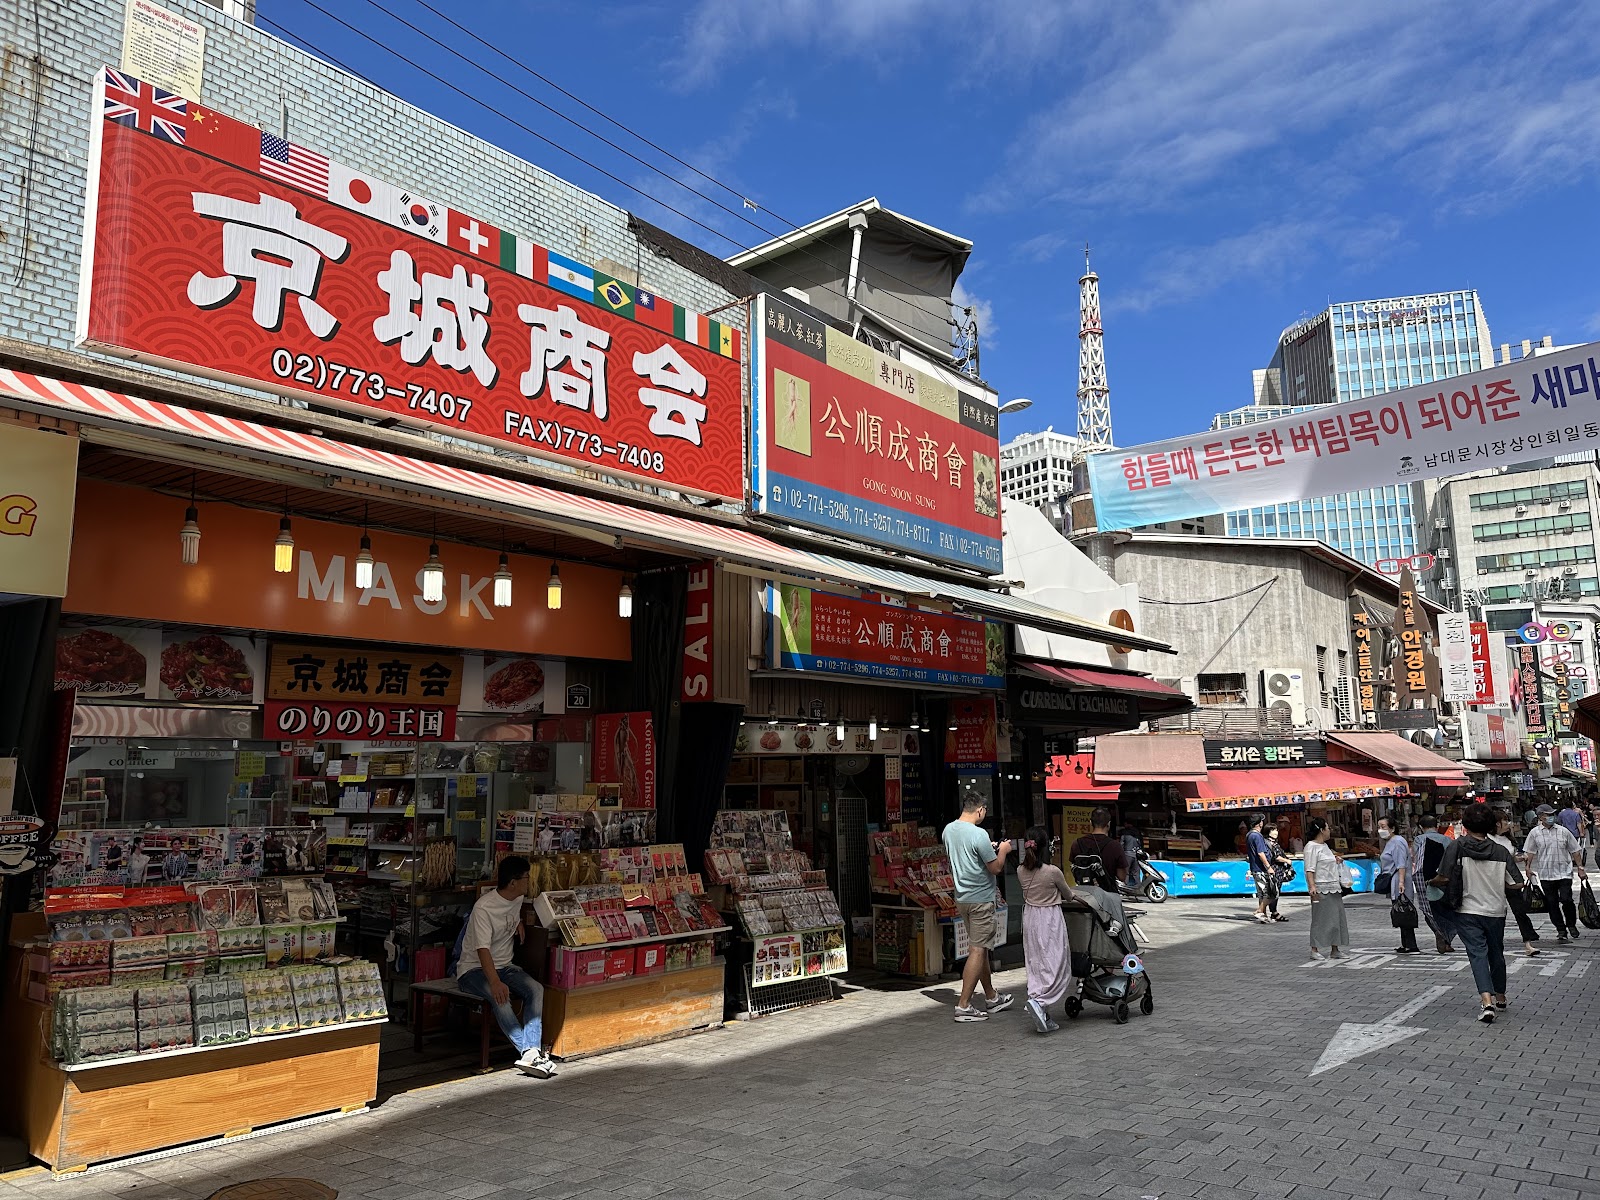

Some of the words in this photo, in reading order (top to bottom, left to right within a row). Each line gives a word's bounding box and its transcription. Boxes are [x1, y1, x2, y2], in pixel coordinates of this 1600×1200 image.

[187, 191, 708, 446] 京城商会
[1363, 295, 1449, 314] COURTYARD
[1283, 311, 1329, 346] COURTYARD
[272, 348, 472, 424] 02)773-7407
[504, 410, 665, 474] FAX)773-7408
[819, 396, 967, 489] 公順成商會
[1121, 447, 1199, 491] 힘들때
[1203, 428, 1285, 477] 든든한
[1289, 401, 1413, 457] 버팀목이
[1418, 378, 1521, 432] 되어준
[863, 477, 887, 496] GONG
[891, 486, 912, 502] SOON
[915, 494, 936, 511] SUNG
[684, 566, 709, 698] SALE
[855, 617, 952, 658] 公順成商會
[286, 653, 452, 697] 京城商会
[1401, 629, 1427, 691] 안경원
[173, 686, 242, 698] チャンジャ
[573, 695, 585, 705] 20
[1020, 690, 1076, 711] CURRENCY
[1080, 694, 1129, 714] EXCHANGE
[278, 705, 444, 738] のりのり王国
[644, 718, 654, 764] Korean
[1220, 746, 1261, 762] 효자손
[1264, 746, 1304, 762] 왕만두
[888, 812, 901, 820] SALE
